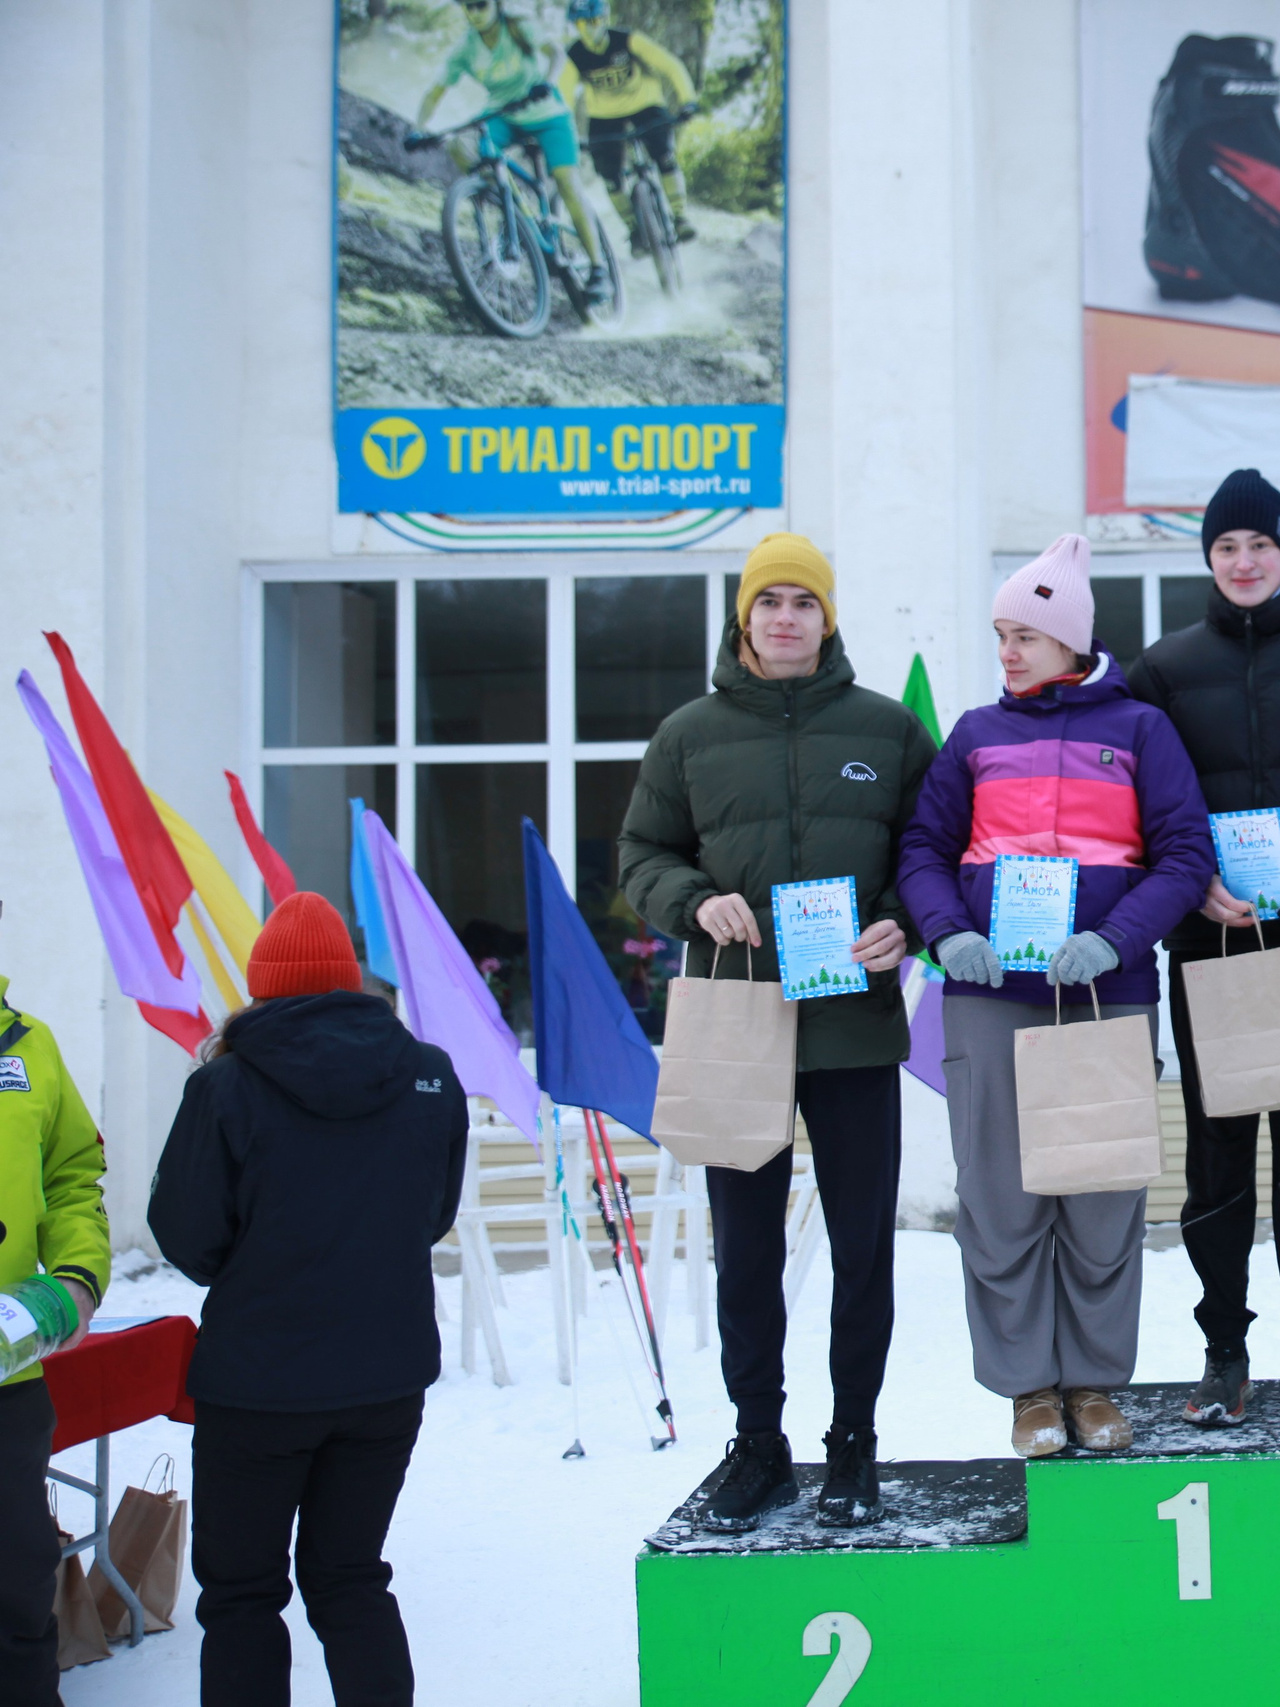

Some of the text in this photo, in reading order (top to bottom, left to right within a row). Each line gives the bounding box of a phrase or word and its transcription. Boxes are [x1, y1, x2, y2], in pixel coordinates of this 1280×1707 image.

[559, 474, 751, 499] www.trial-sport.ru
[1008, 885, 1061, 897] ГРАМОТА
[789, 909, 843, 923] ГРАМОТА
[1157, 1482, 1212, 1600] 1
[802, 1611, 872, 1707] 2
